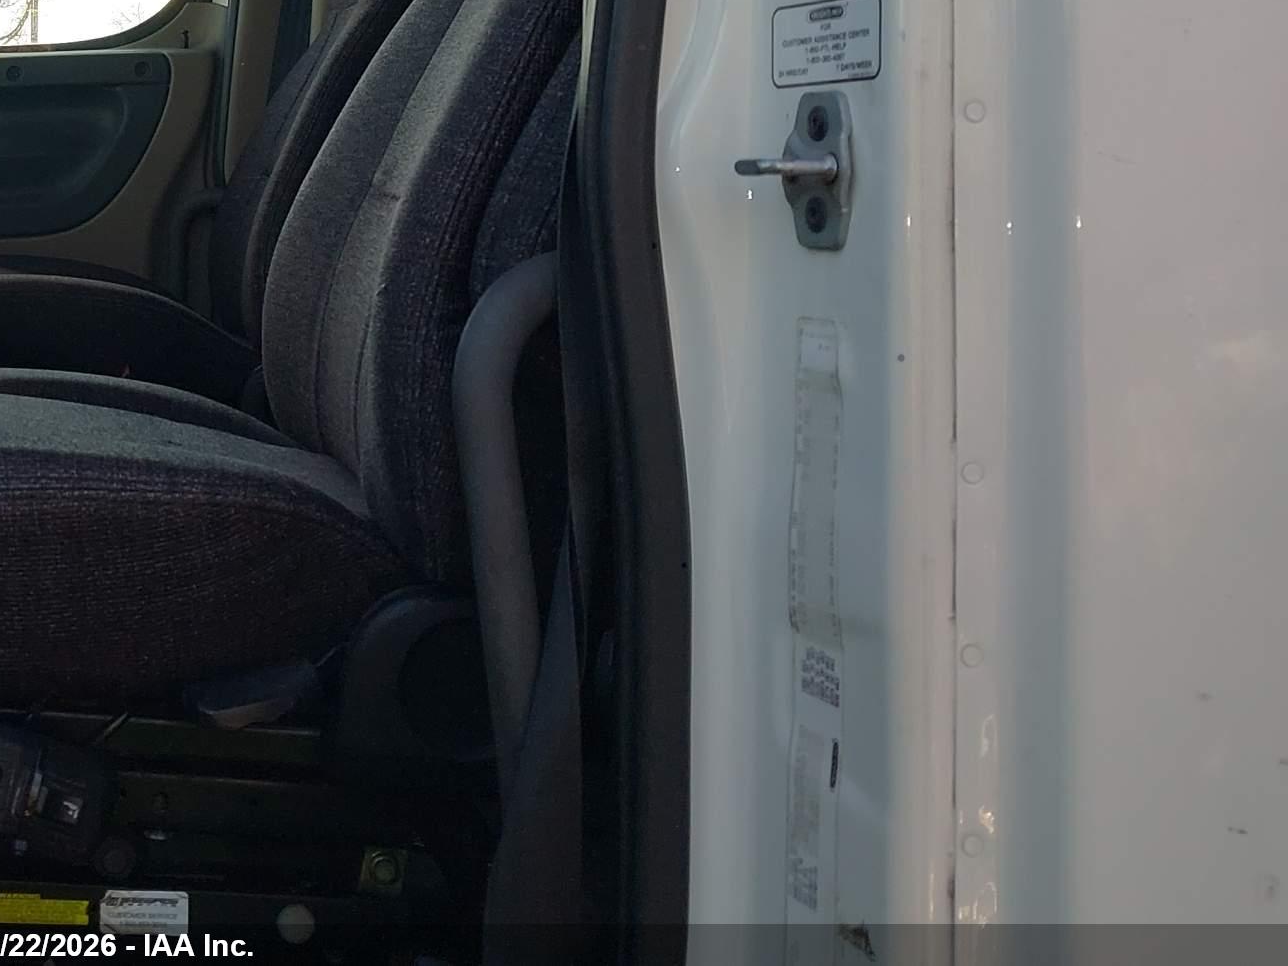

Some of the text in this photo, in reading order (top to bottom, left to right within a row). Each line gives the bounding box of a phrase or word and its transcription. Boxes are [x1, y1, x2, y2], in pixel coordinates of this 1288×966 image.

[782, 28, 870, 48] CUSTOMER ASSISTANCE CENTER
